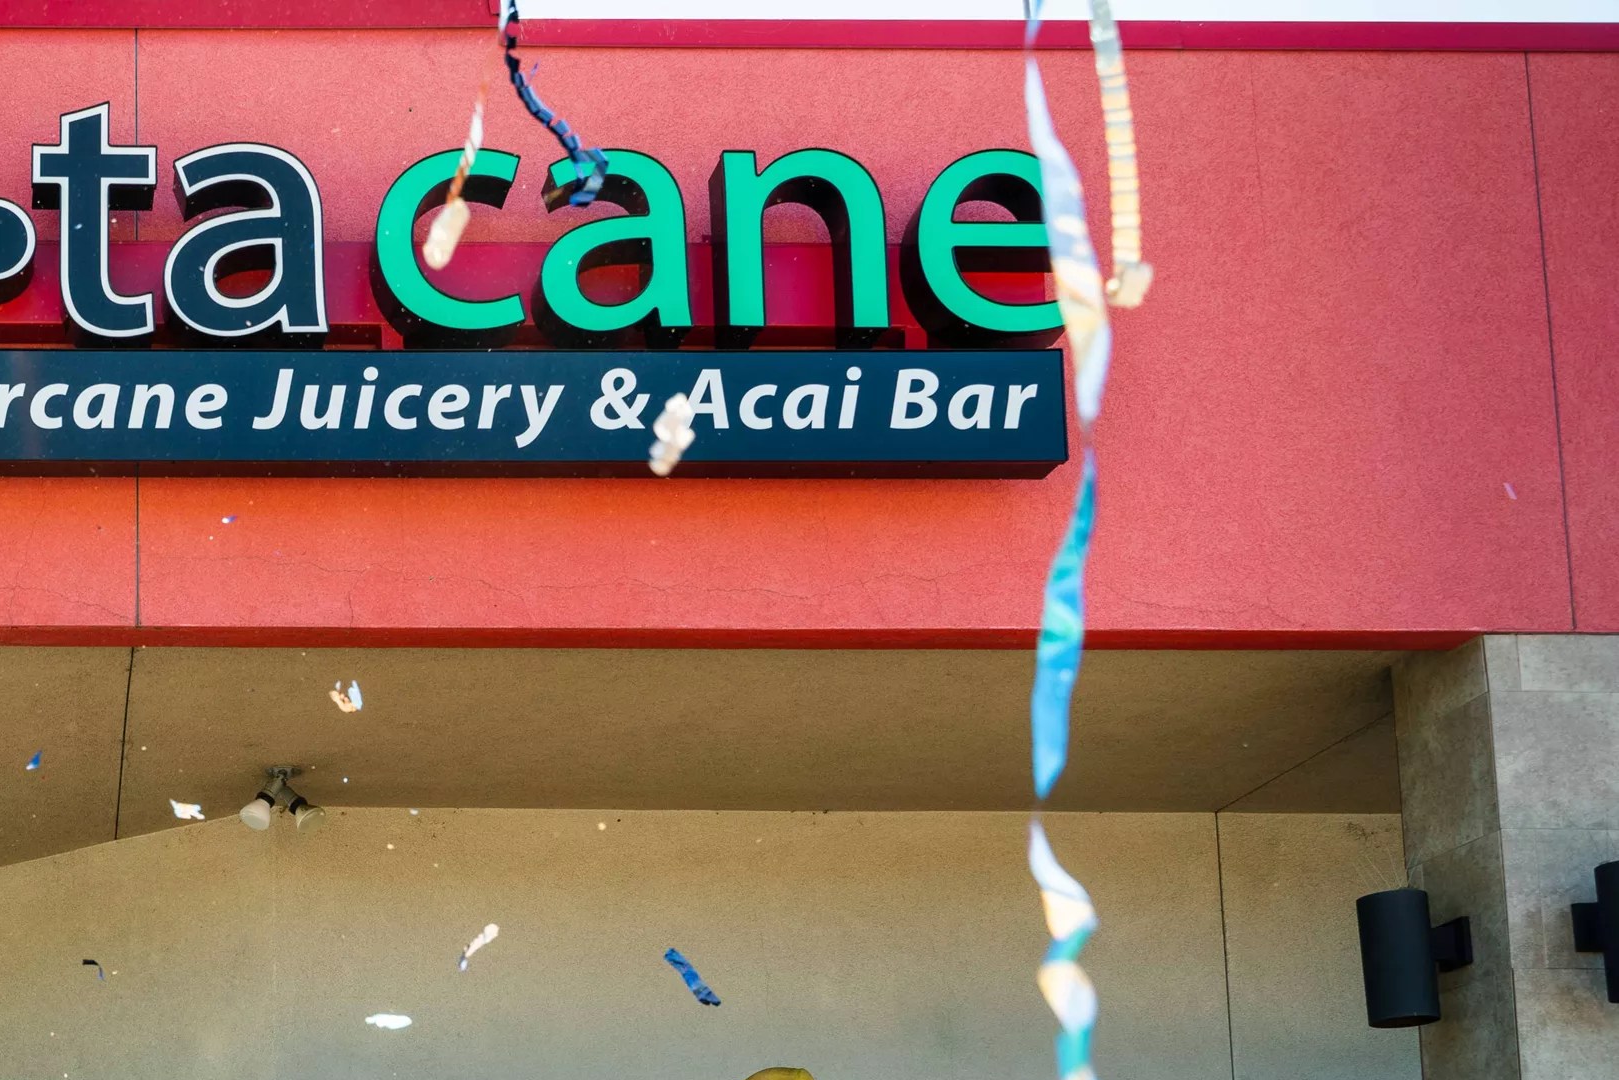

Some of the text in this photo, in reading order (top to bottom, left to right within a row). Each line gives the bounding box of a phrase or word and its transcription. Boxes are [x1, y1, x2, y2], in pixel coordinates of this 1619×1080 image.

[376, 148, 1063, 333] cane
[252, 366, 565, 449] Juicery
[590, 367, 649, 430] &
[688, 366, 862, 430] Acai
[890, 368, 1038, 430] Bar
